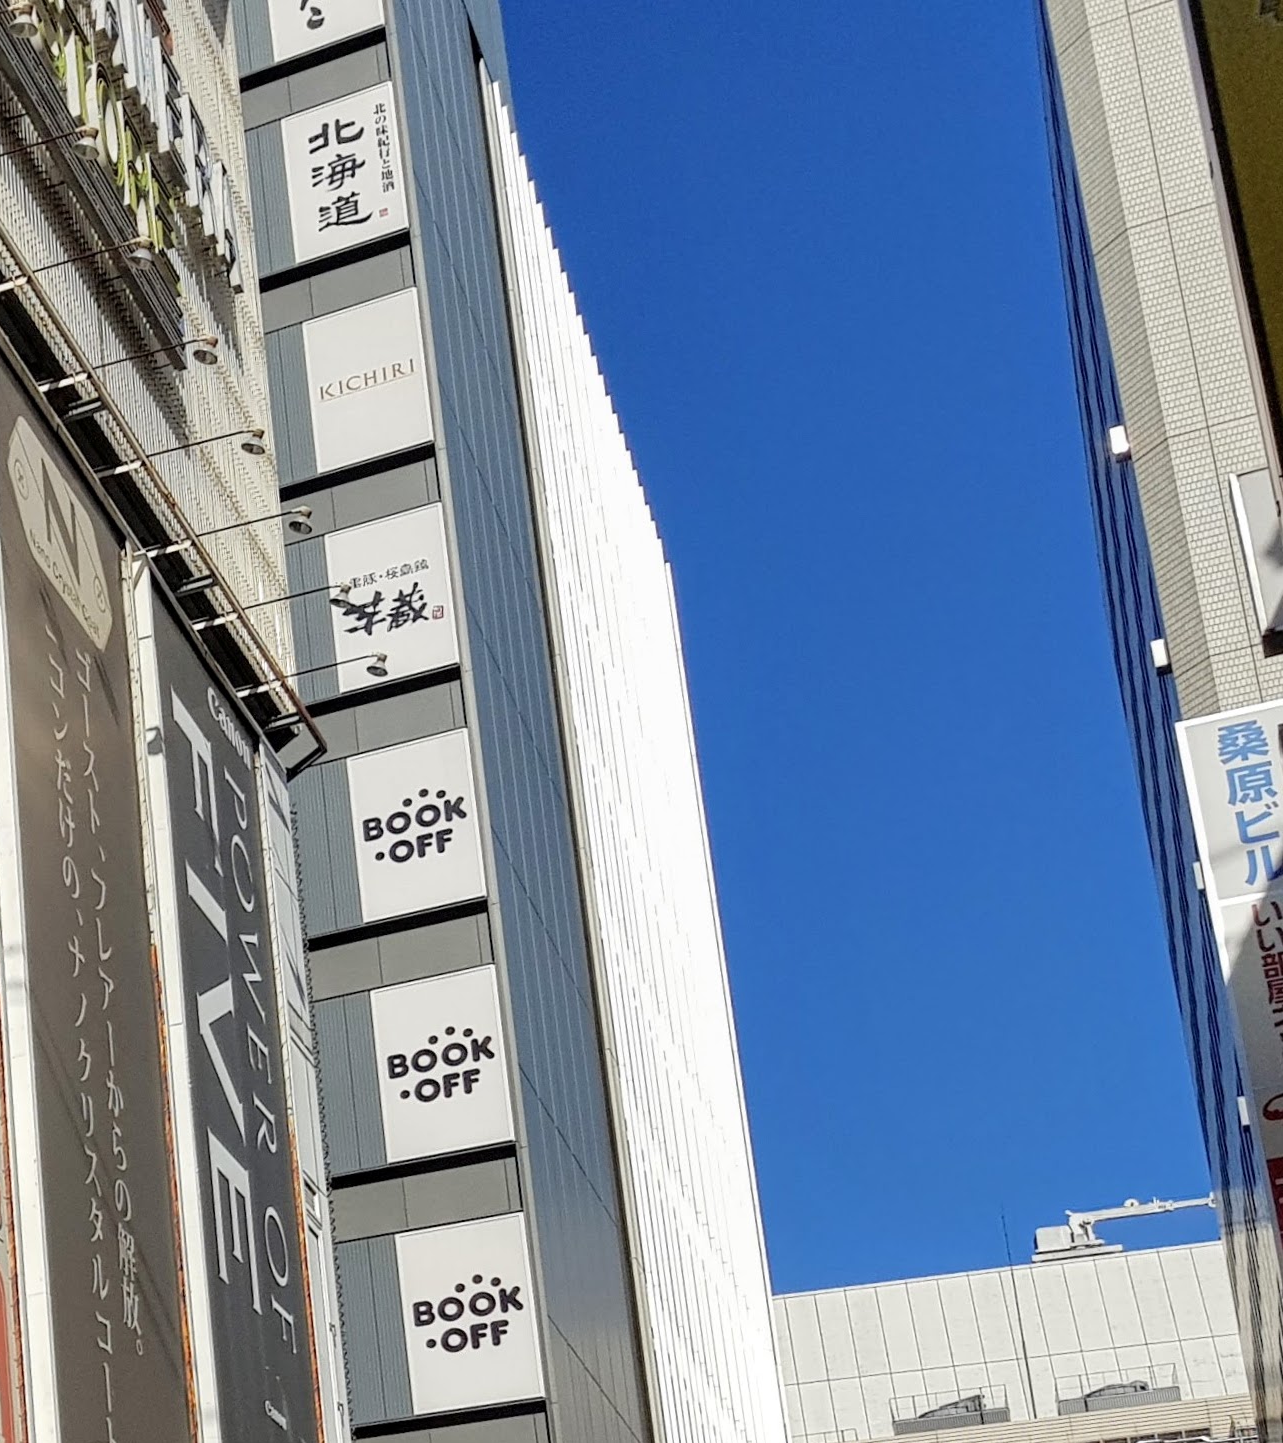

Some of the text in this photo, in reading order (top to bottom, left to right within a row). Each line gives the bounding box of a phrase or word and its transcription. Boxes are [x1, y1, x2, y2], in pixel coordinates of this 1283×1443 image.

[307, 118, 374, 232] 北海道
[319, 357, 416, 401] KICHIRI
[206, 686, 254, 771] Canon
[361, 791, 468, 843] BOOK
[1217, 718, 1283, 887] 桑原ビル
[170, 683, 265, 1316] FIVE
[224, 766, 298, 1356] POWER OF
[386, 1032, 495, 1081] BOOK
[412, 1282, 524, 1328] BOOK
